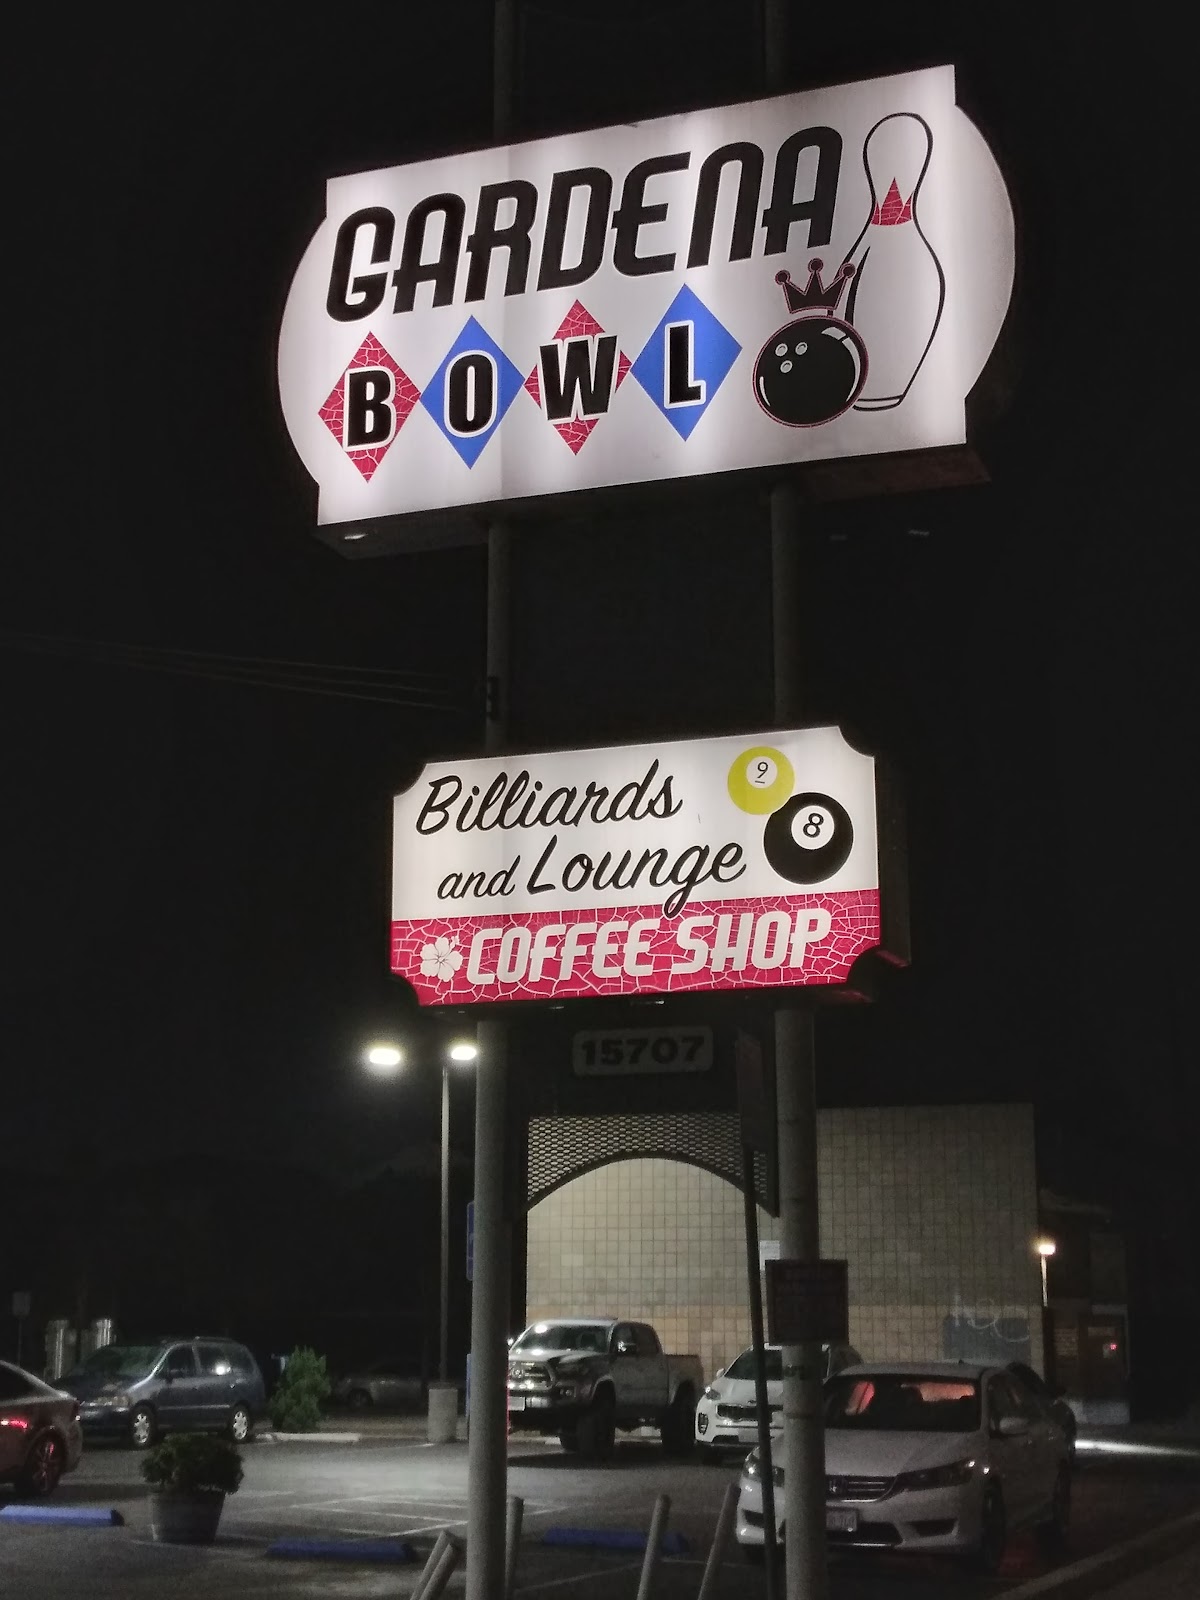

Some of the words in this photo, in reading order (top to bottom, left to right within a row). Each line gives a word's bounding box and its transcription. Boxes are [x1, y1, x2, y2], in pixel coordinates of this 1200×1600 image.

[327, 126, 843, 322] GARDENA
[343, 322, 706, 450] BOWL
[415, 758, 683, 836] Billiards
[756, 761, 770, 780] 9
[802, 812, 824, 838] 8
[437, 855, 521, 900] and
[526, 834, 747, 919] Lounge
[466, 918, 661, 985] COFFEE
[670, 907, 832, 975] SHOP
[581, 1035, 705, 1066] 15707
